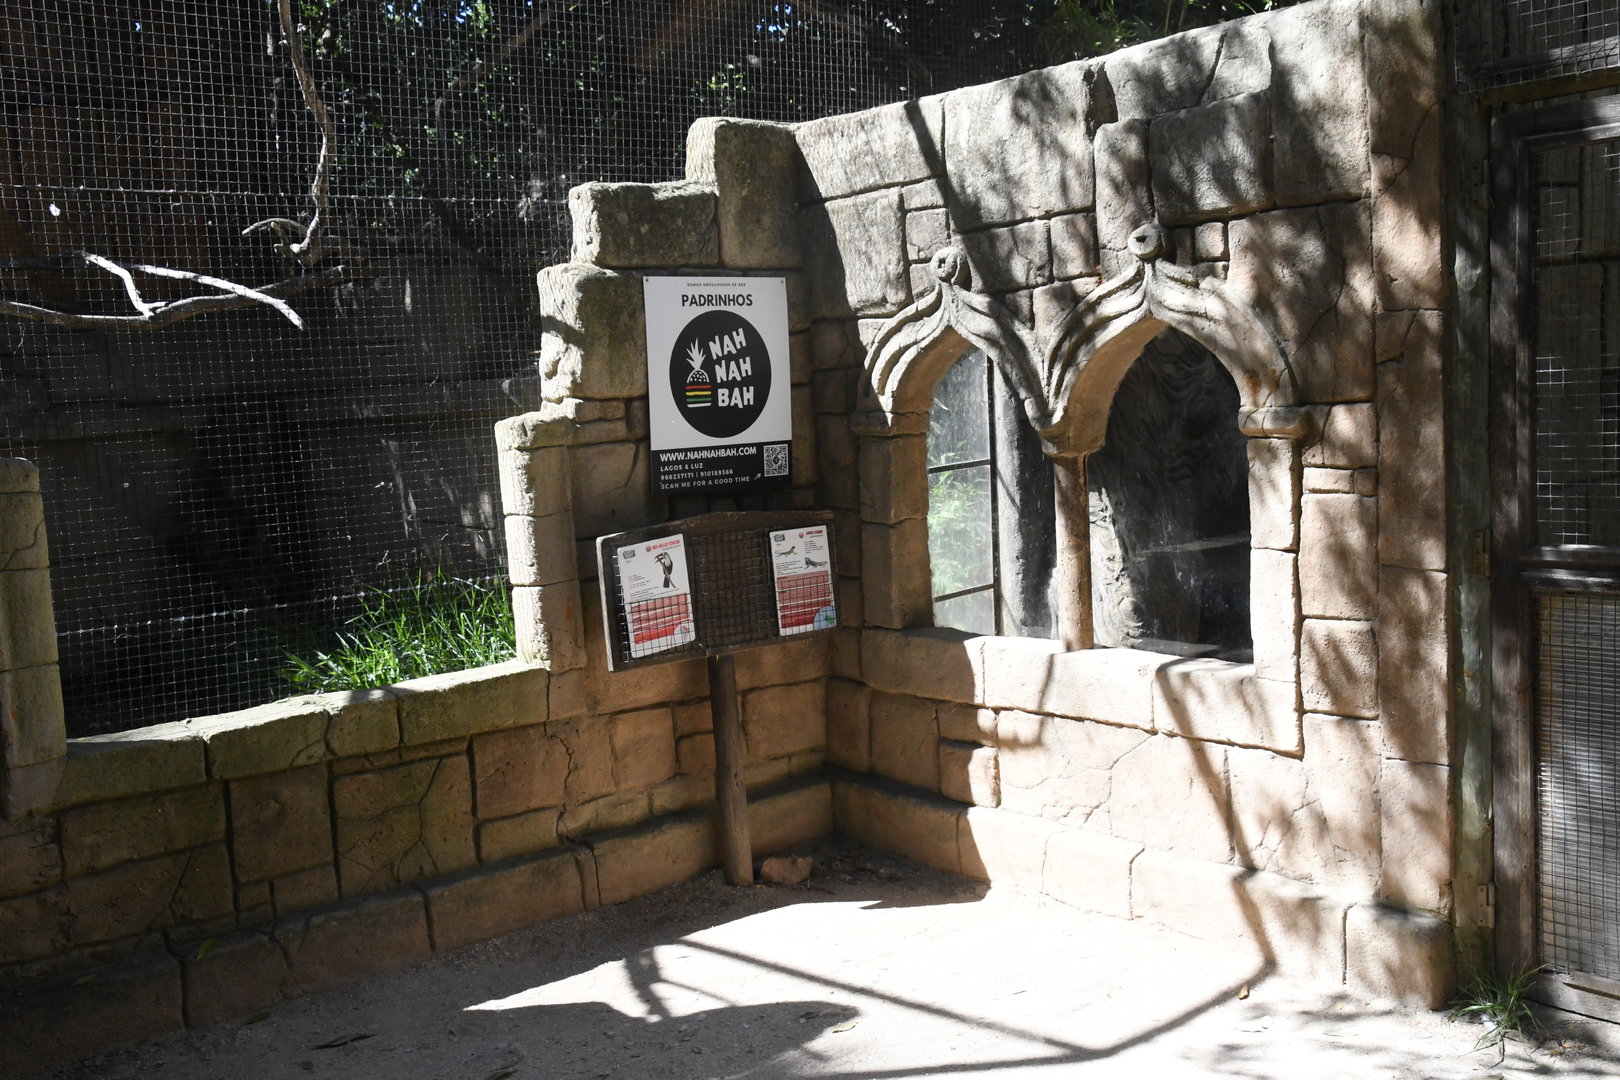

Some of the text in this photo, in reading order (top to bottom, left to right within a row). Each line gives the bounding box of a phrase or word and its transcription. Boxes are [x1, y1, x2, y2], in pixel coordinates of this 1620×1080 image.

[681, 294, 753, 307] PADRINHOS
[709, 327, 747, 360] NAH
[714, 356, 752, 384] NAH
[717, 386, 754, 409] BAH
[660, 446, 757, 462] WWW.NAHNAHBAH.COM
[660, 464, 683, 472] LAGOS
[660, 472, 694, 480] 966237171
[700, 469, 734, 477] 910189366
